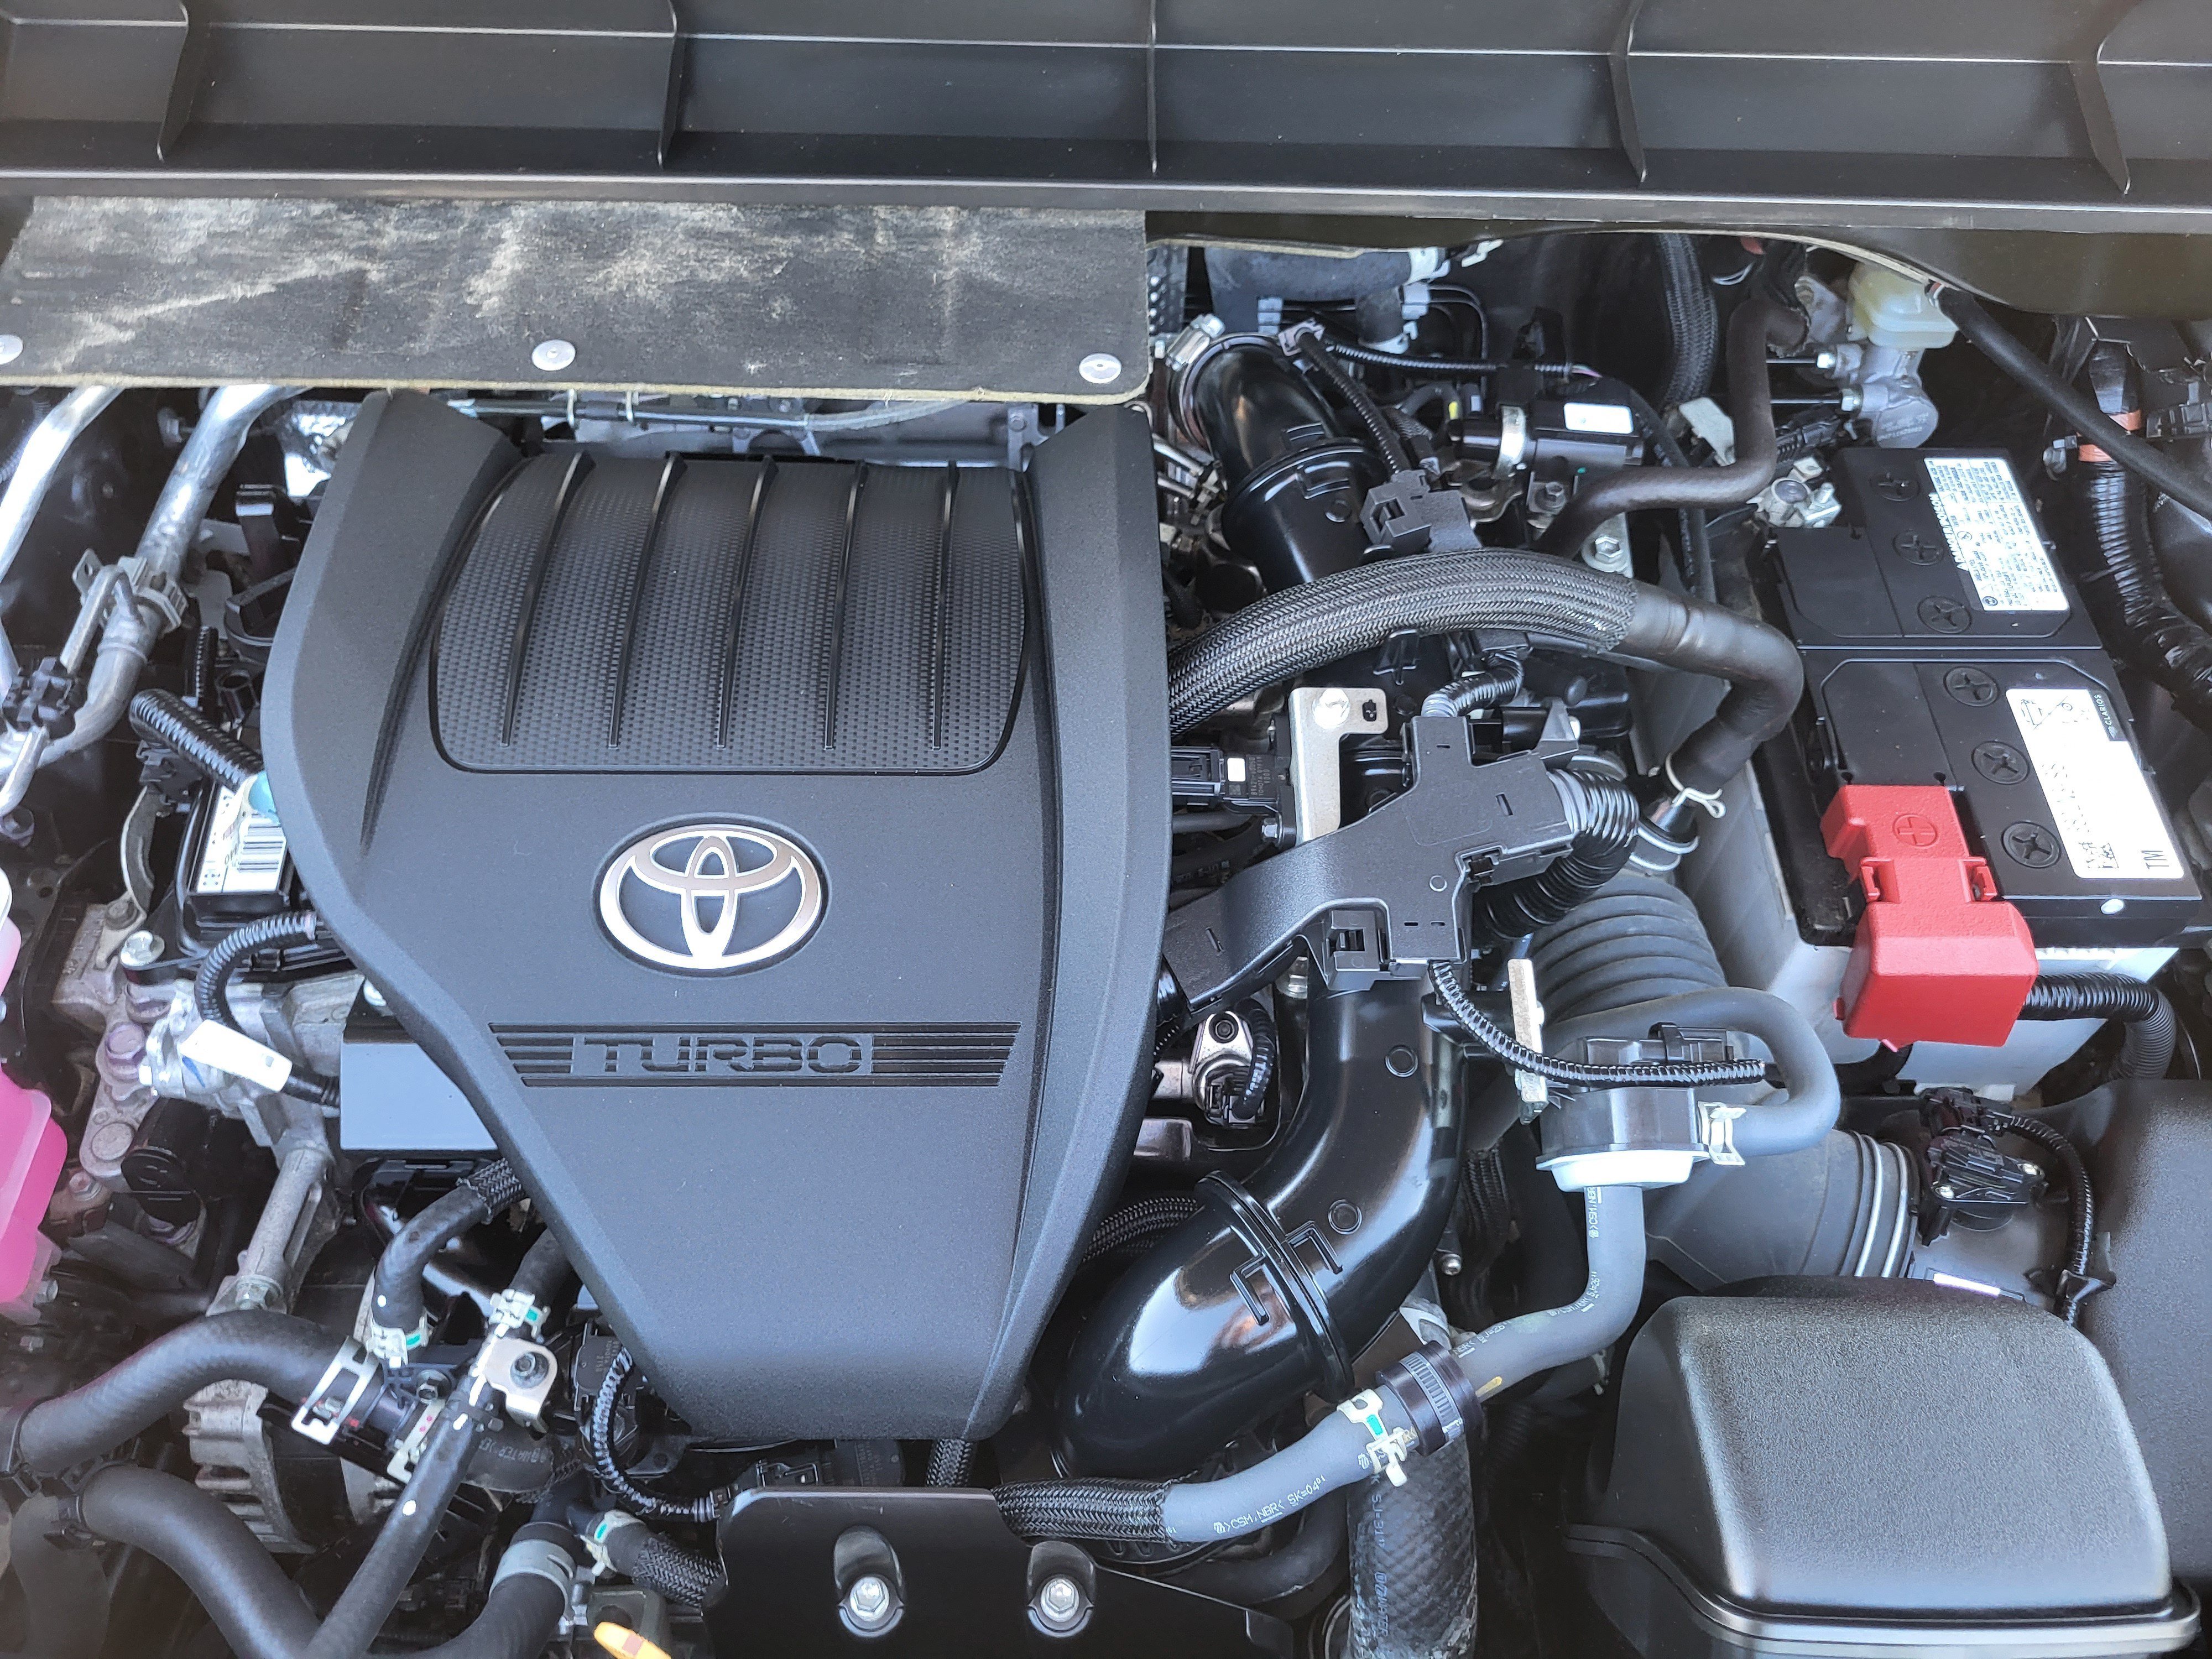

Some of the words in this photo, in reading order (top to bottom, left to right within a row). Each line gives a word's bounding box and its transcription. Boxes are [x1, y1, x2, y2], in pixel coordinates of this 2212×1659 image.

[1928, 492, 1966, 564] DANGER/POISON
[2094, 693, 2112, 726] CLARIOS
[2141, 850, 2169, 869] TM
[584, 1035, 862, 1073] TURBO
